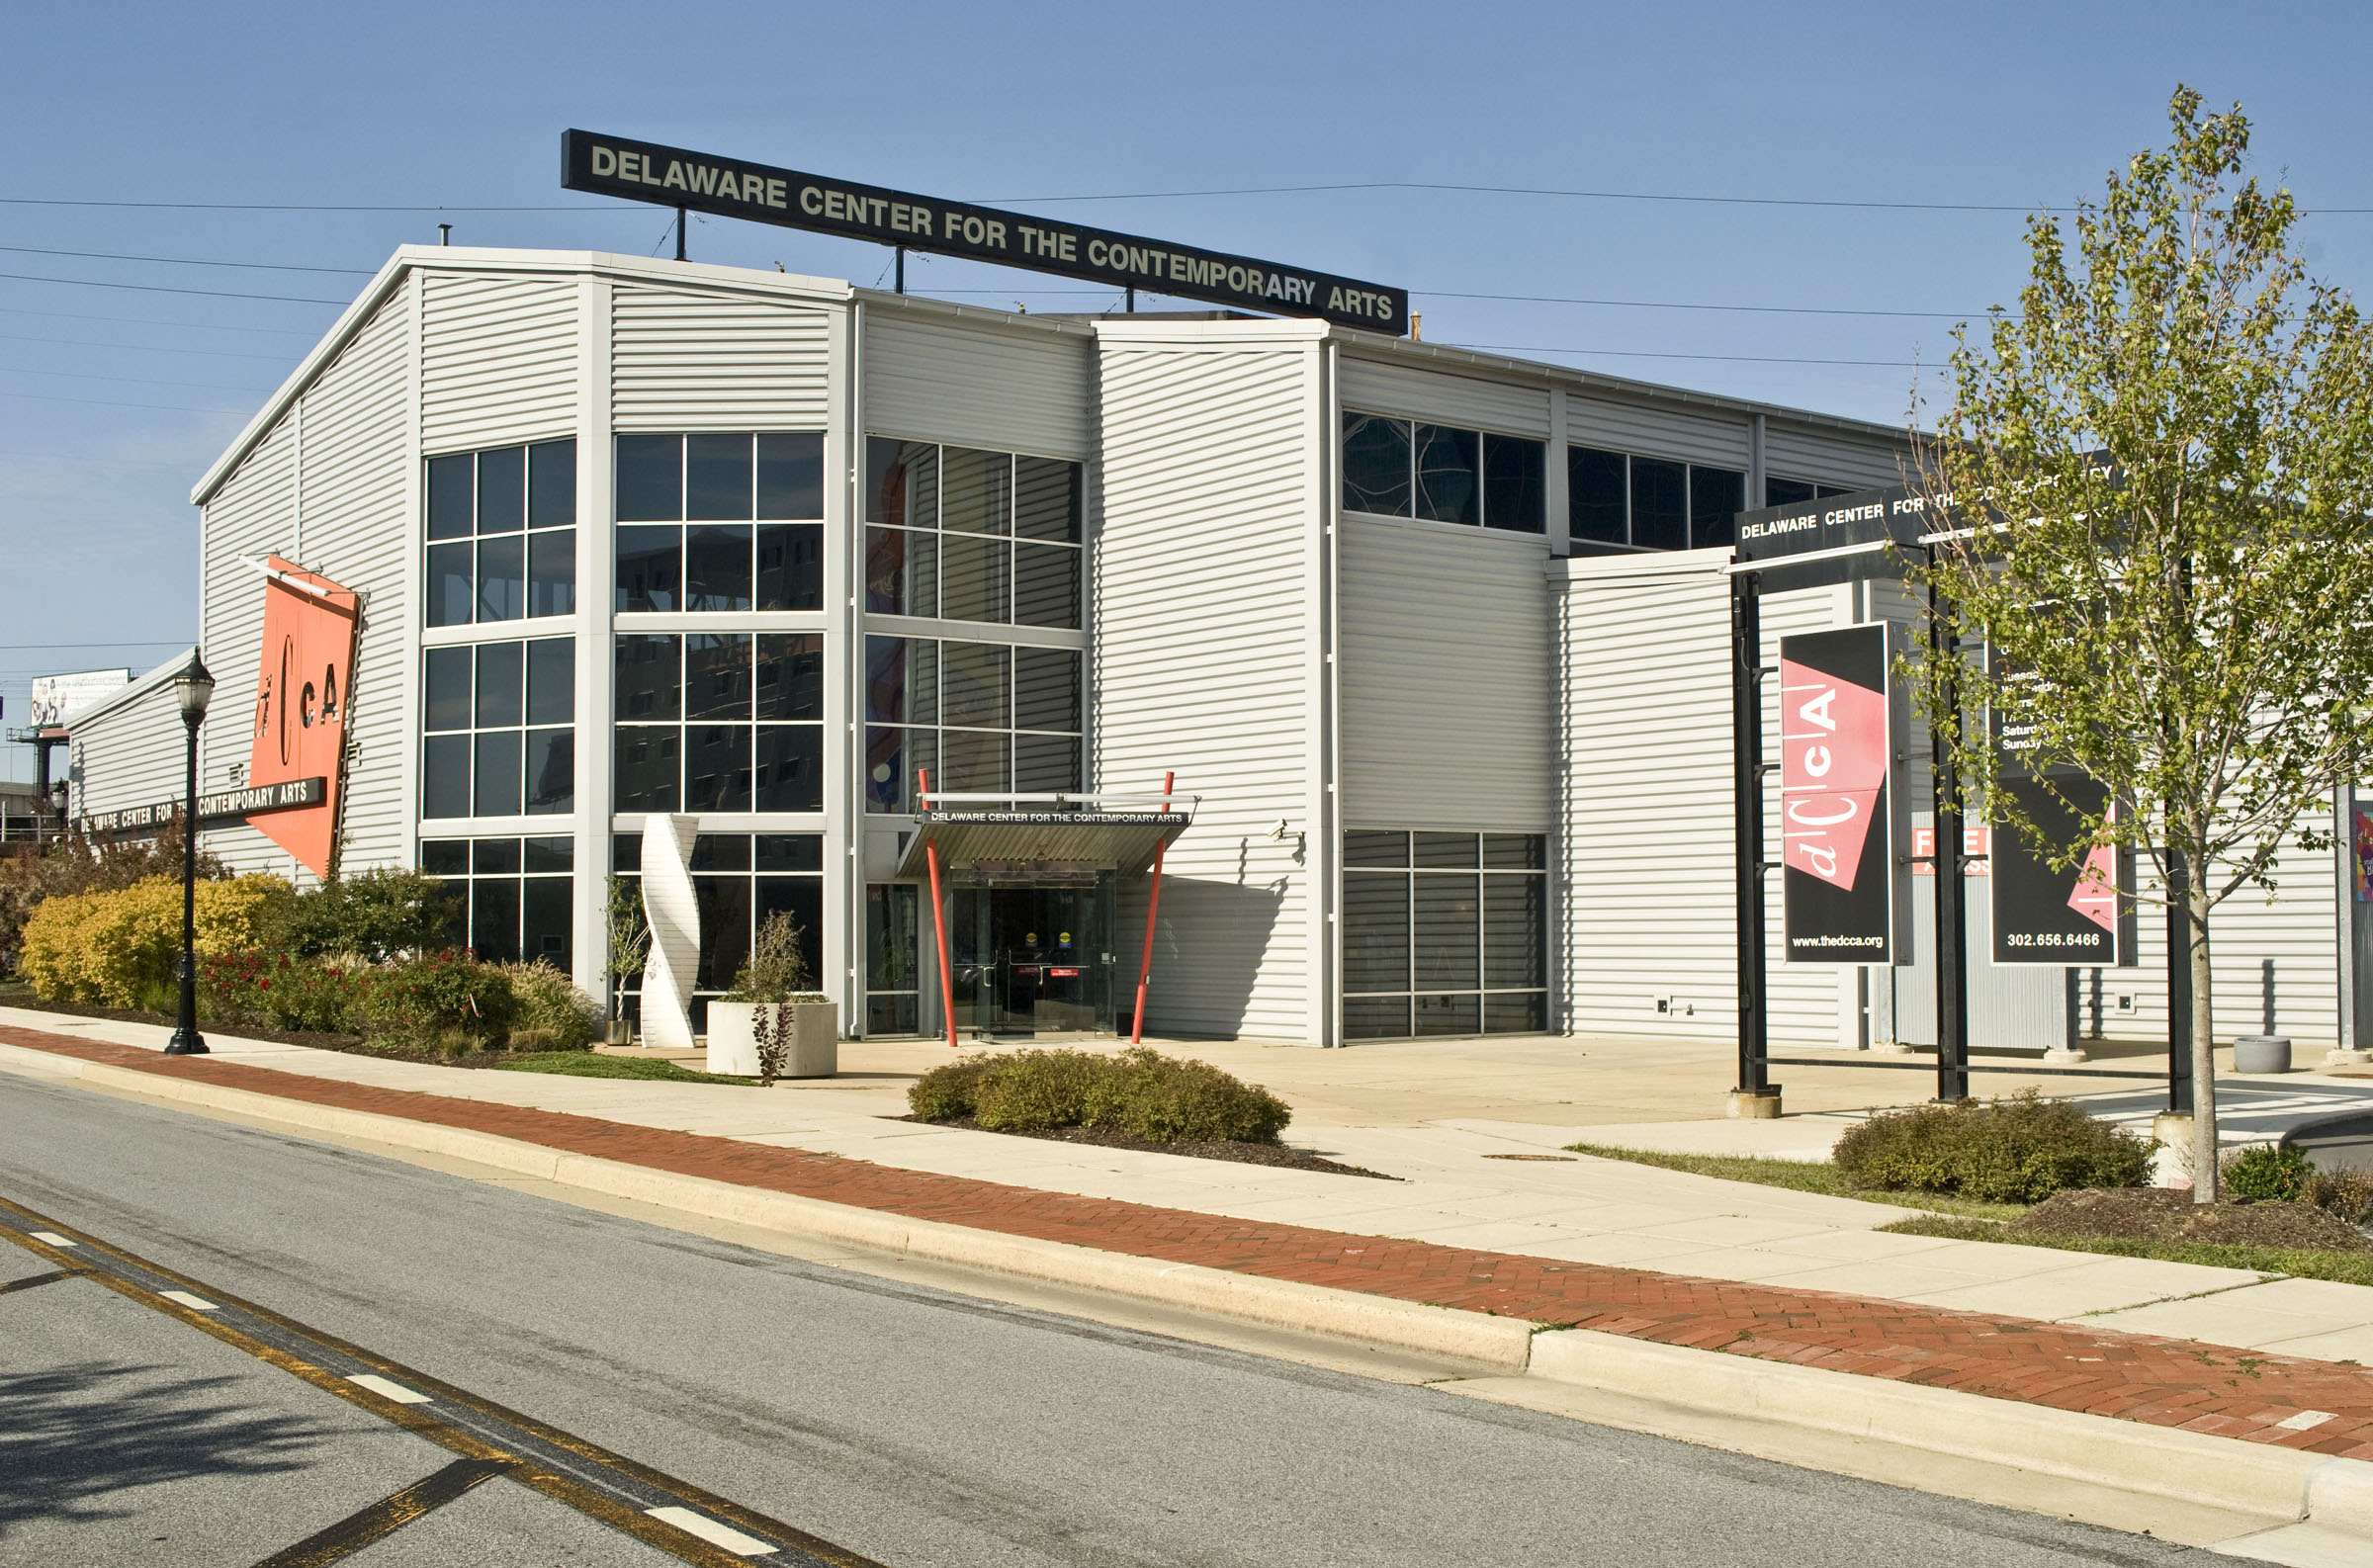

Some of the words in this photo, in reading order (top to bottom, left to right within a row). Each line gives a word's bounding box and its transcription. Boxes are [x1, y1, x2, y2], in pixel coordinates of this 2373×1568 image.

[591, 145, 787, 209] DELAWARE
[800, 186, 932, 236] CENTER
[944, 212, 1007, 250] FOR
[1018, 225, 1077, 262] THE
[1088, 238, 1317, 305] CONTEMPORARY
[1327, 285, 1393, 320] ARTS
[1741, 514, 1817, 540] DELAWARE
[1825, 503, 1885, 526] CENTER
[1892, 496, 1925, 516] FOR
[1935, 490, 1965, 508] TH
[2002, 725, 2049, 737] Saturdy
[122, 807, 151, 828] CENTER
[156, 804, 172, 823] FOR
[198, 787, 274, 816] CONTEMPORARY
[280, 781, 307, 804] ARTS
[931, 812, 986, 822] DELAWARE
[988, 813, 1027, 822] CENTER
[1030, 813, 1050, 823] FOR
[1052, 814, 1072, 823] THE
[1074, 814, 1155, 823] CONTEMPORARY
[1157, 814, 1183, 823] ARTS
[1793, 935, 1884, 948] www.thedcca.org
[2007, 933, 2100, 946] 302.656.6466
